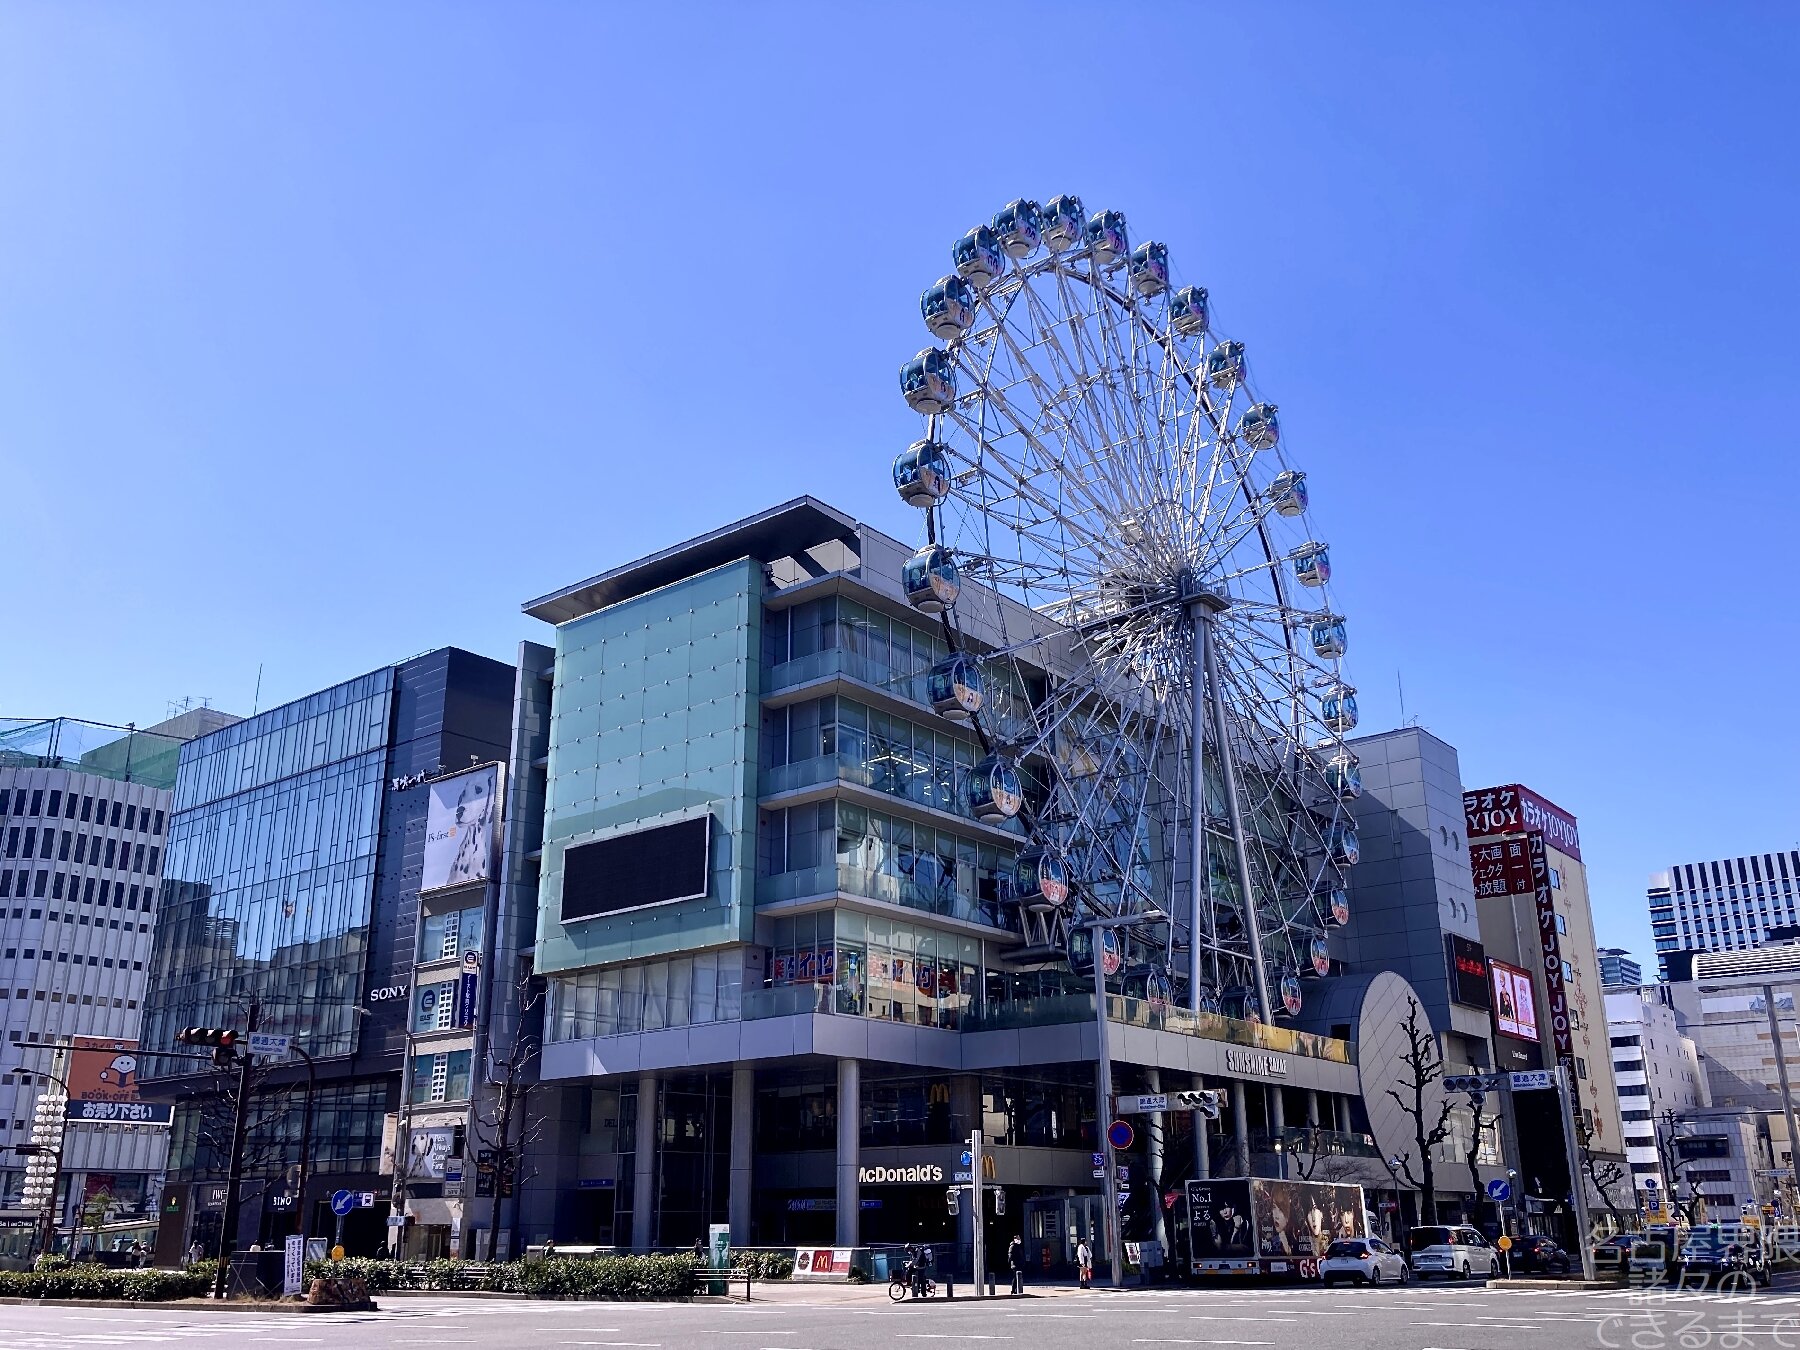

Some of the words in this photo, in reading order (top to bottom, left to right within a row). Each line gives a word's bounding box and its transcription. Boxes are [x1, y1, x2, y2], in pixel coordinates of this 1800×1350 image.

[1464, 790, 1515, 812] ラオケ
[1467, 807, 1518, 832] YJOY
[370, 985, 408, 1001] SONY
[1226, 1048, 1269, 1076] SUNSHINE
[82, 1101, 153, 1120] お売り下さい
[858, 1164, 943, 1183] McDonald's
[1192, 1192, 1212, 1203] No.1
[1194, 1209, 1211, 1220] よる
[1299, 1258, 1316, 1278] G's
